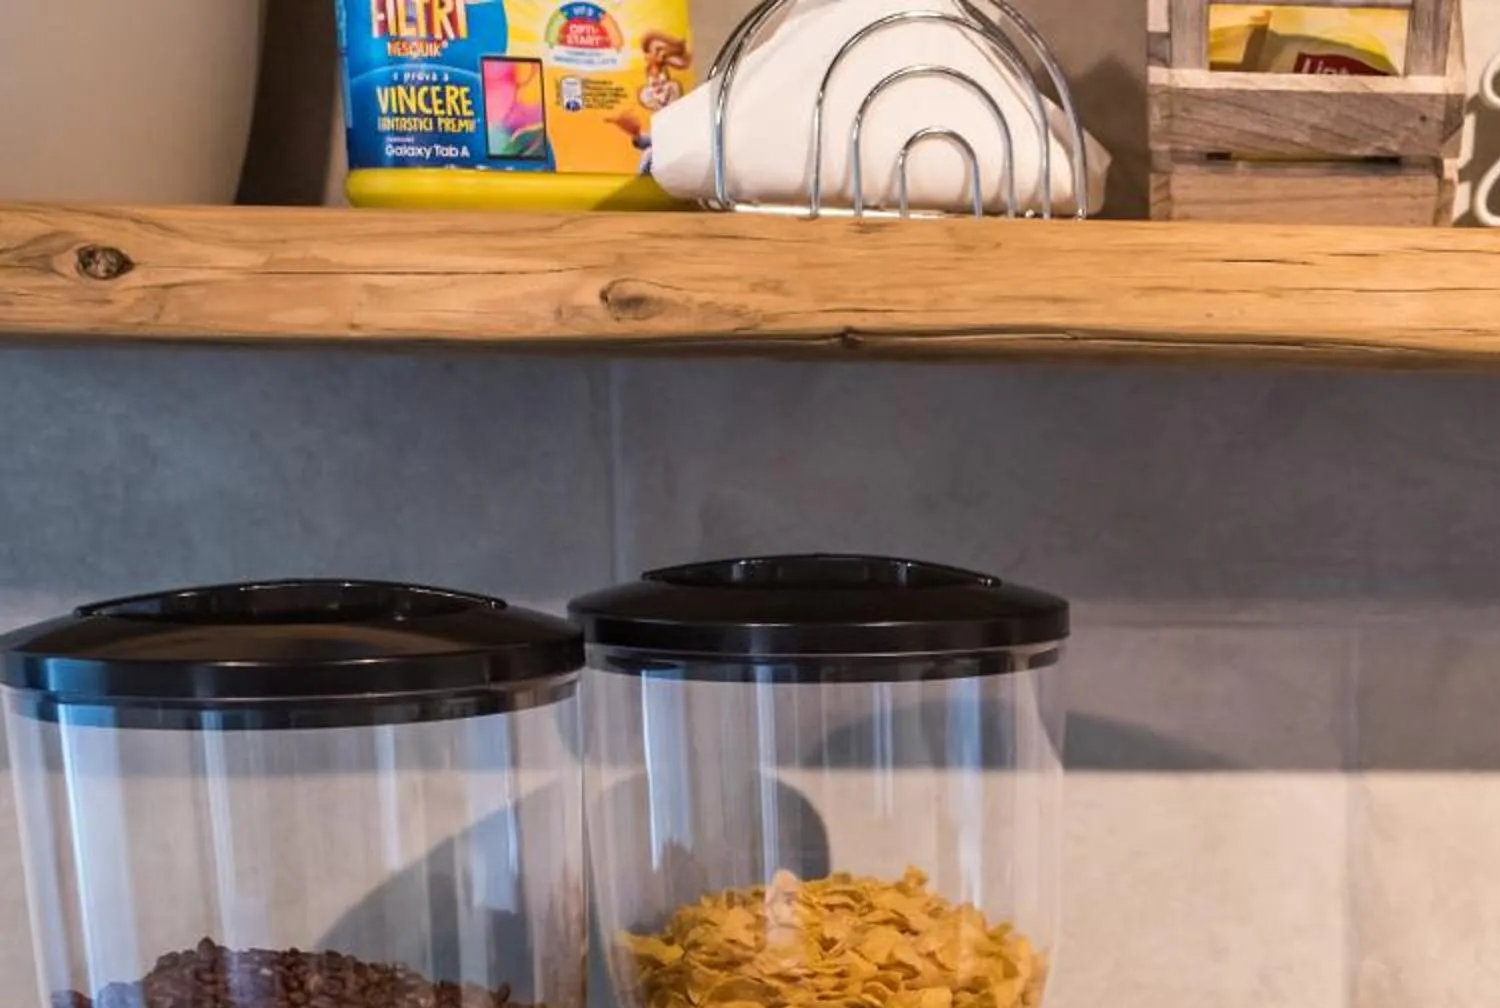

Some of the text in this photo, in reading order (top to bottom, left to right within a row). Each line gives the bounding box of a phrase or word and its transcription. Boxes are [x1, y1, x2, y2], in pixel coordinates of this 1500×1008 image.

[376, 84, 475, 116] VINCERE
[385, 144, 470, 159] Galaxy Tab A
